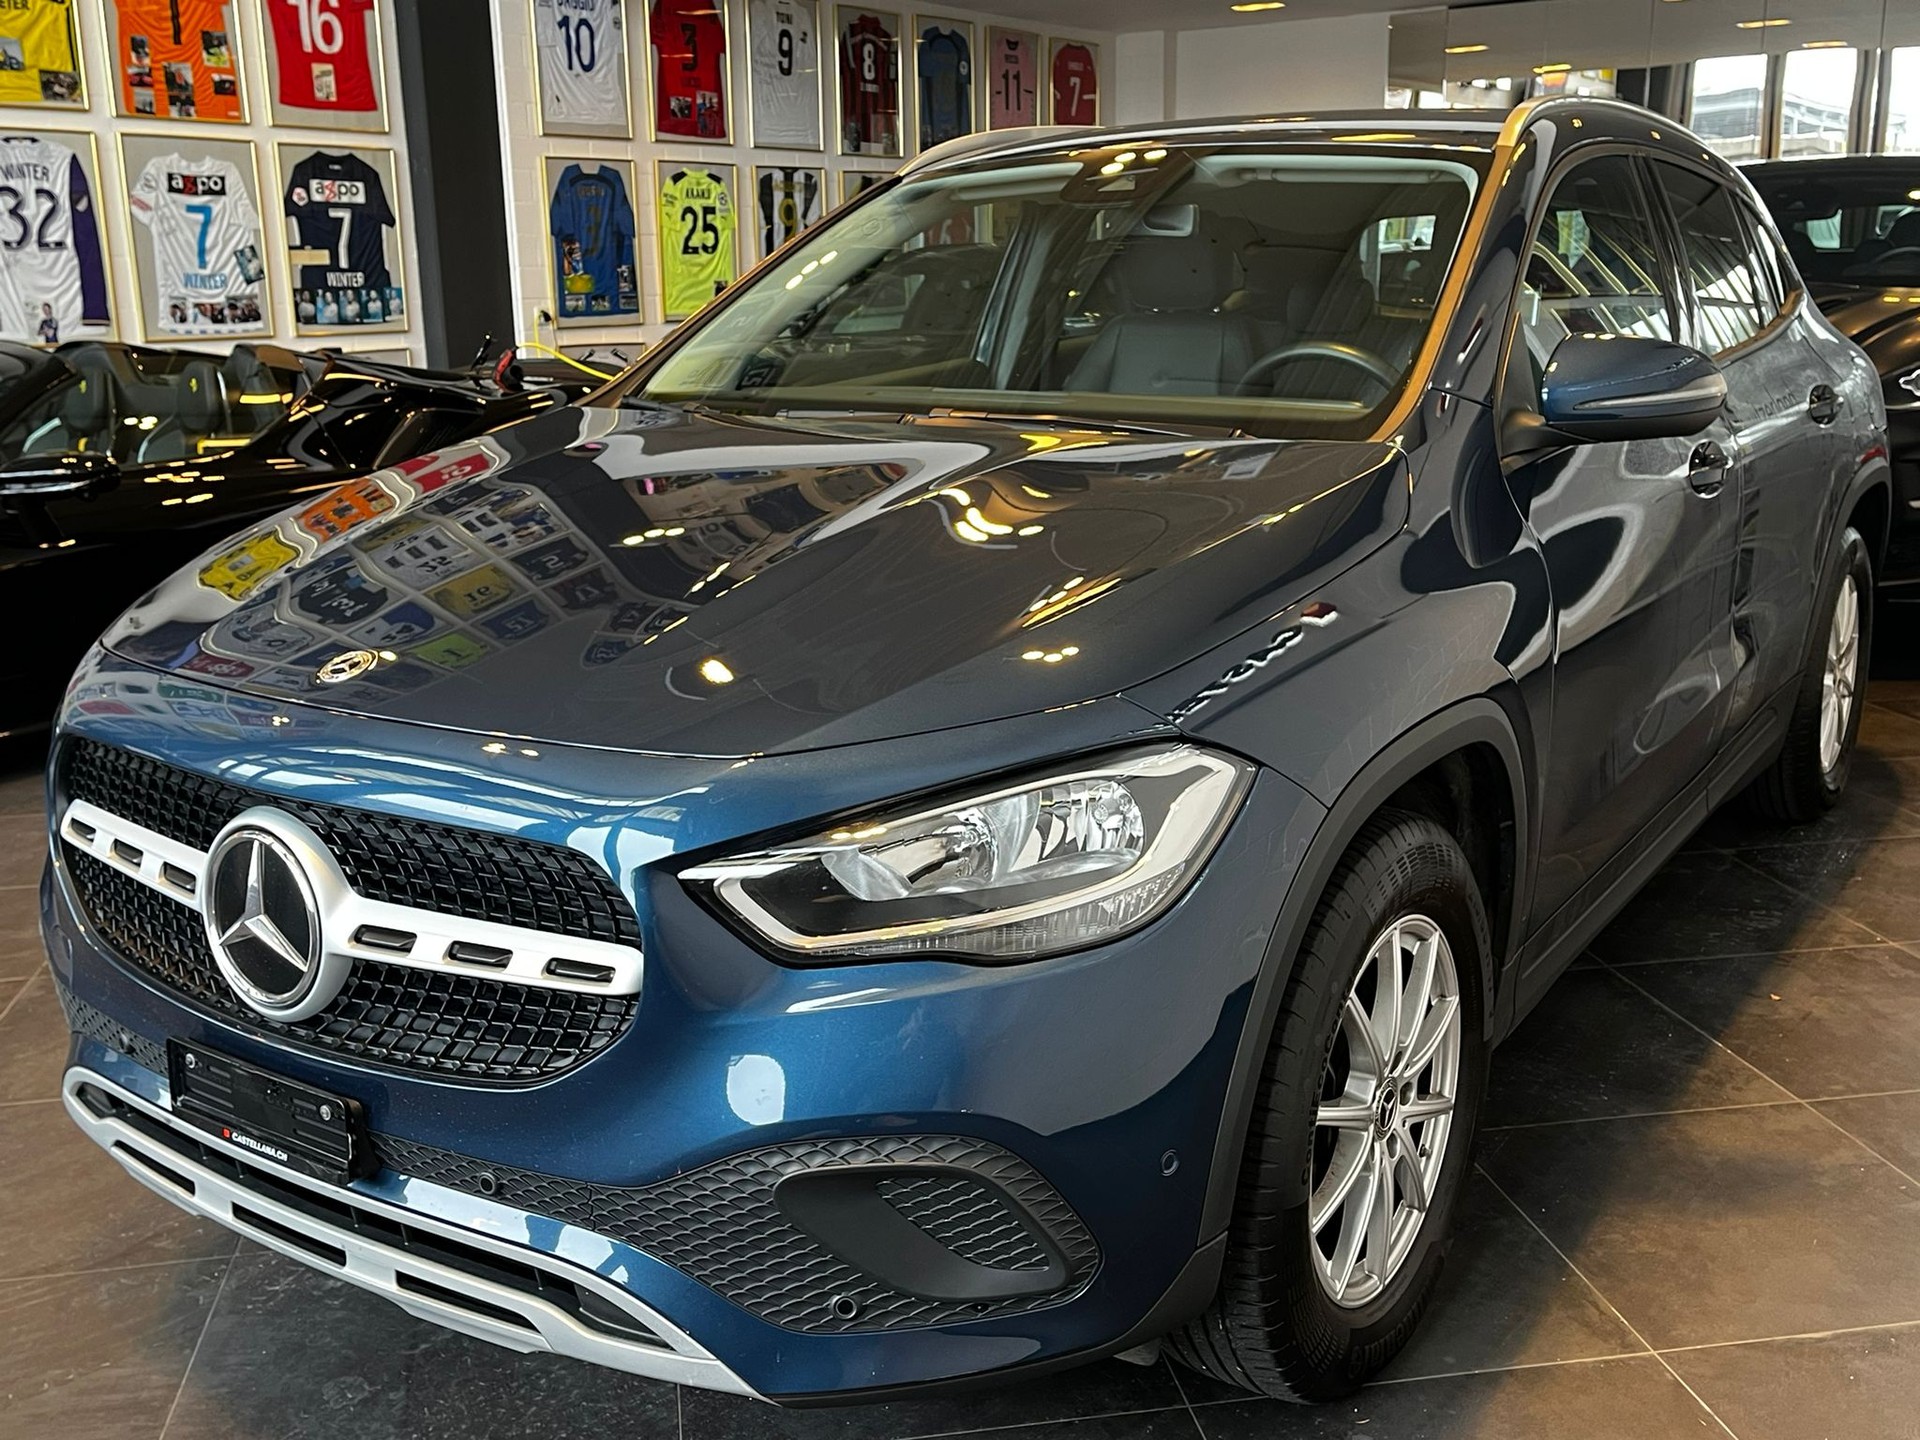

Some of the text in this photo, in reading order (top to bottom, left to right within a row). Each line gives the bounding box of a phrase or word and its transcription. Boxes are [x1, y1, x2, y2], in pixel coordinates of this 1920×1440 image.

[286, 0, 344, 55] 16
[557, 15, 595, 72] 10
[679, 22, 699, 71] 3
[778, 28, 792, 76] 9
[862, 42, 876, 81] 8
[1001, 69, 1022, 111] 11
[1069, 77, 1081, 117] 7
[1, 163, 50, 182] WINTER
[0, 187, 67, 250] 32
[185, 204, 214, 269] 7
[328, 208, 352, 268] 7
[681, 206, 719, 255] 25
[182, 272, 228, 290] WINTER
[326, 271, 365, 287] WINTER
